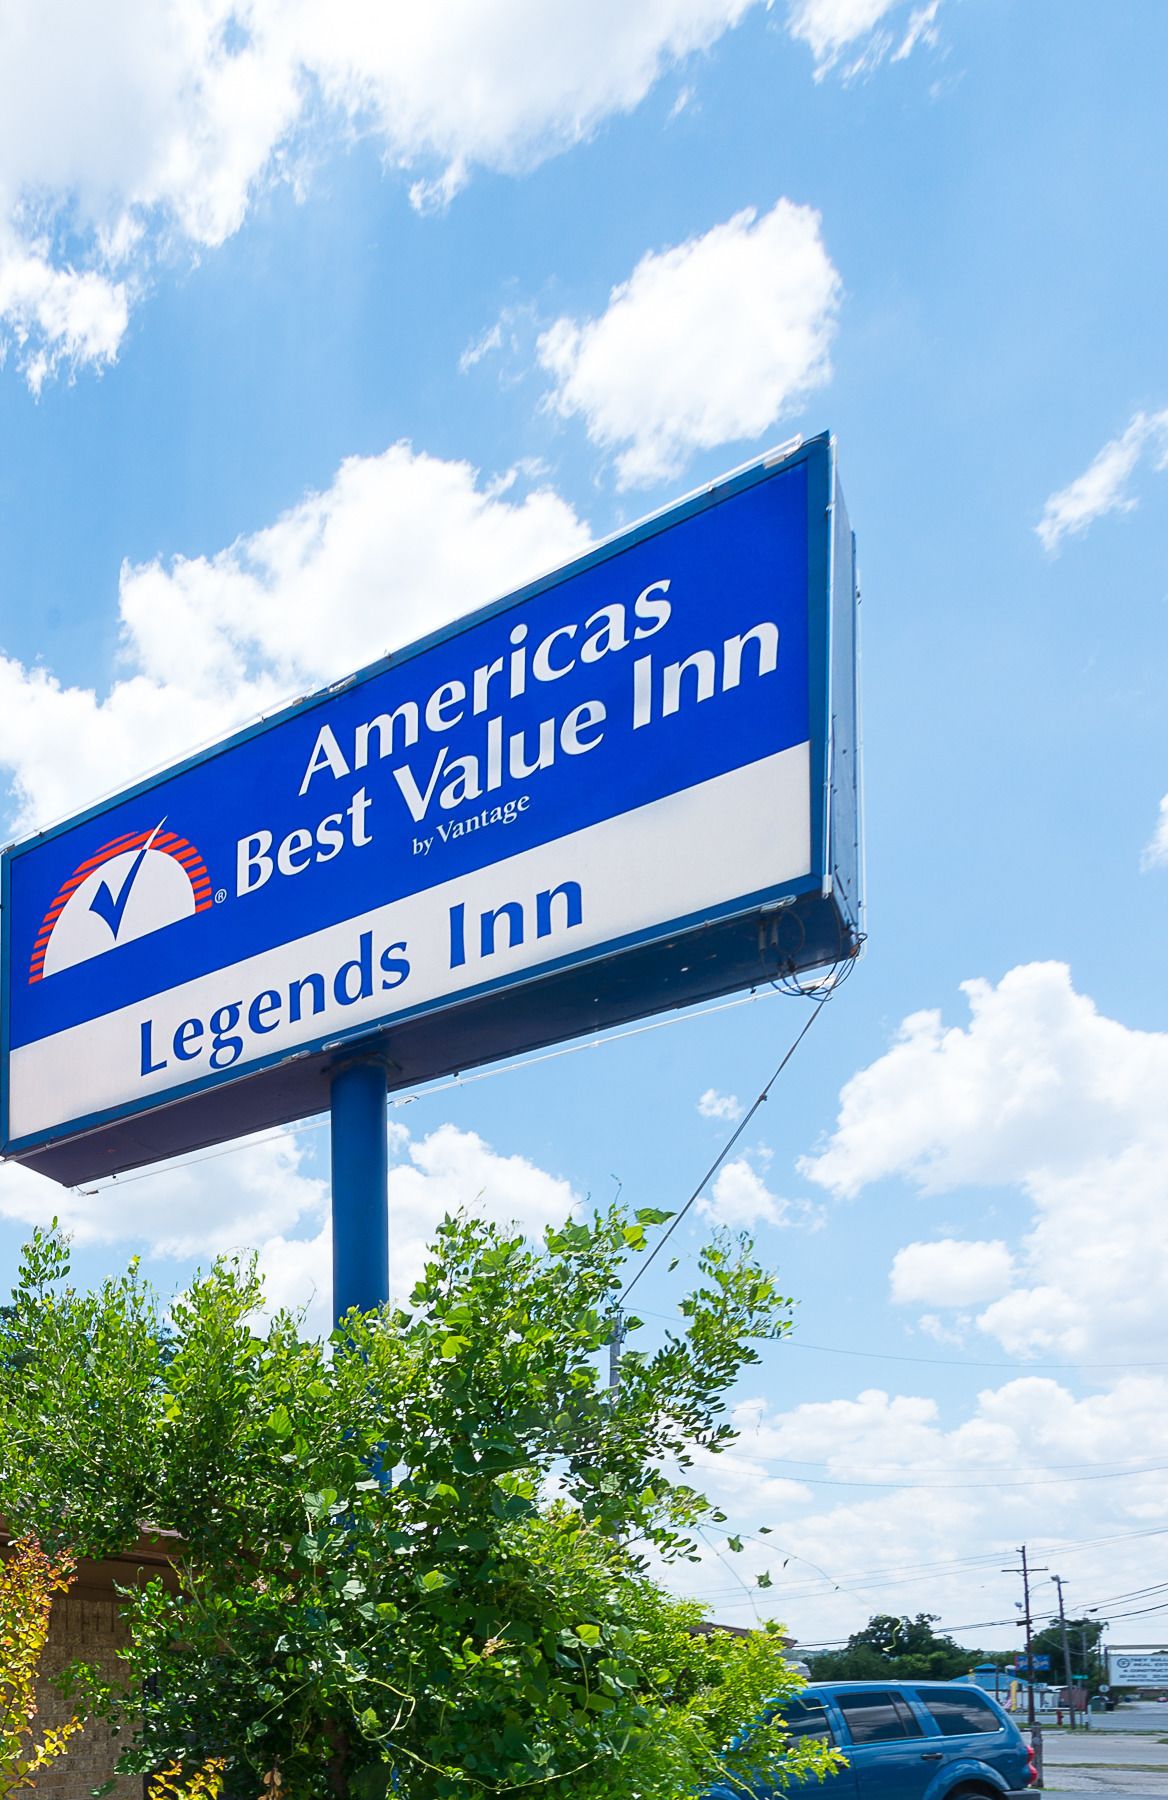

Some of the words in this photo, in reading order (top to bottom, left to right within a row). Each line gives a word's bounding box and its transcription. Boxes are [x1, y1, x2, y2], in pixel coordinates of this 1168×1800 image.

[236, 786, 374, 898] Best
[392, 700, 607, 823] Value
[633, 622, 780, 730] Inn
[298, 579, 672, 797] Americas
[412, 837, 434, 856] by
[435, 795, 531, 843] Vantage
[140, 930, 411, 1077] Legends
[449, 880, 583, 969] Inn
